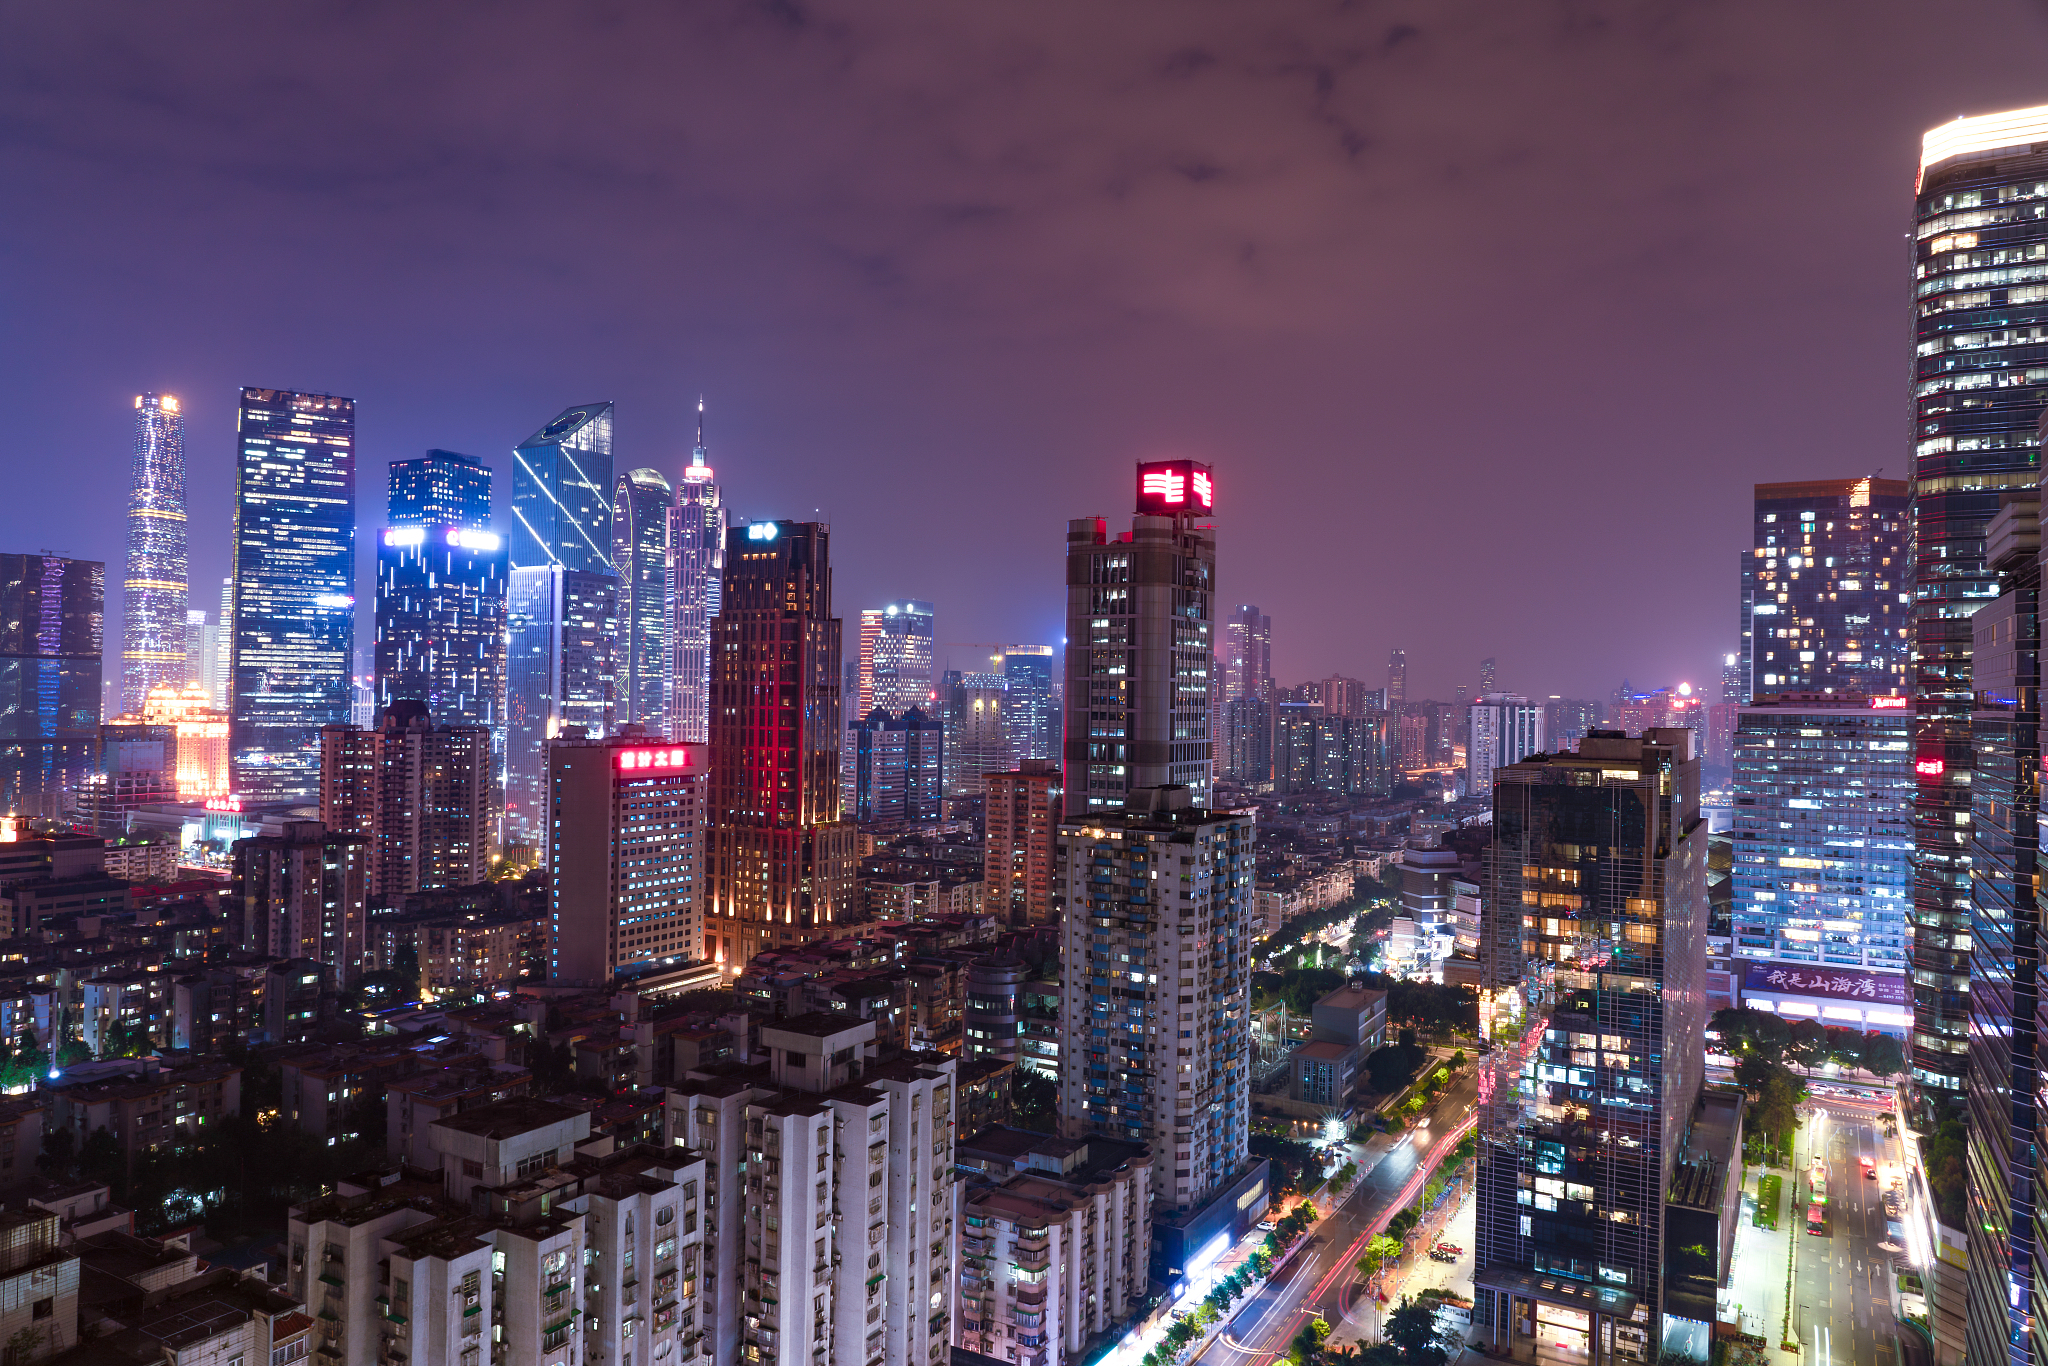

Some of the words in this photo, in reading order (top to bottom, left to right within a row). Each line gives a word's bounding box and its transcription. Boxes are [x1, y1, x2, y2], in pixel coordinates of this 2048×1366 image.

[278, 391, 343, 408] 广州证券
[1766, 969, 1876, 998] 我是山海湾
